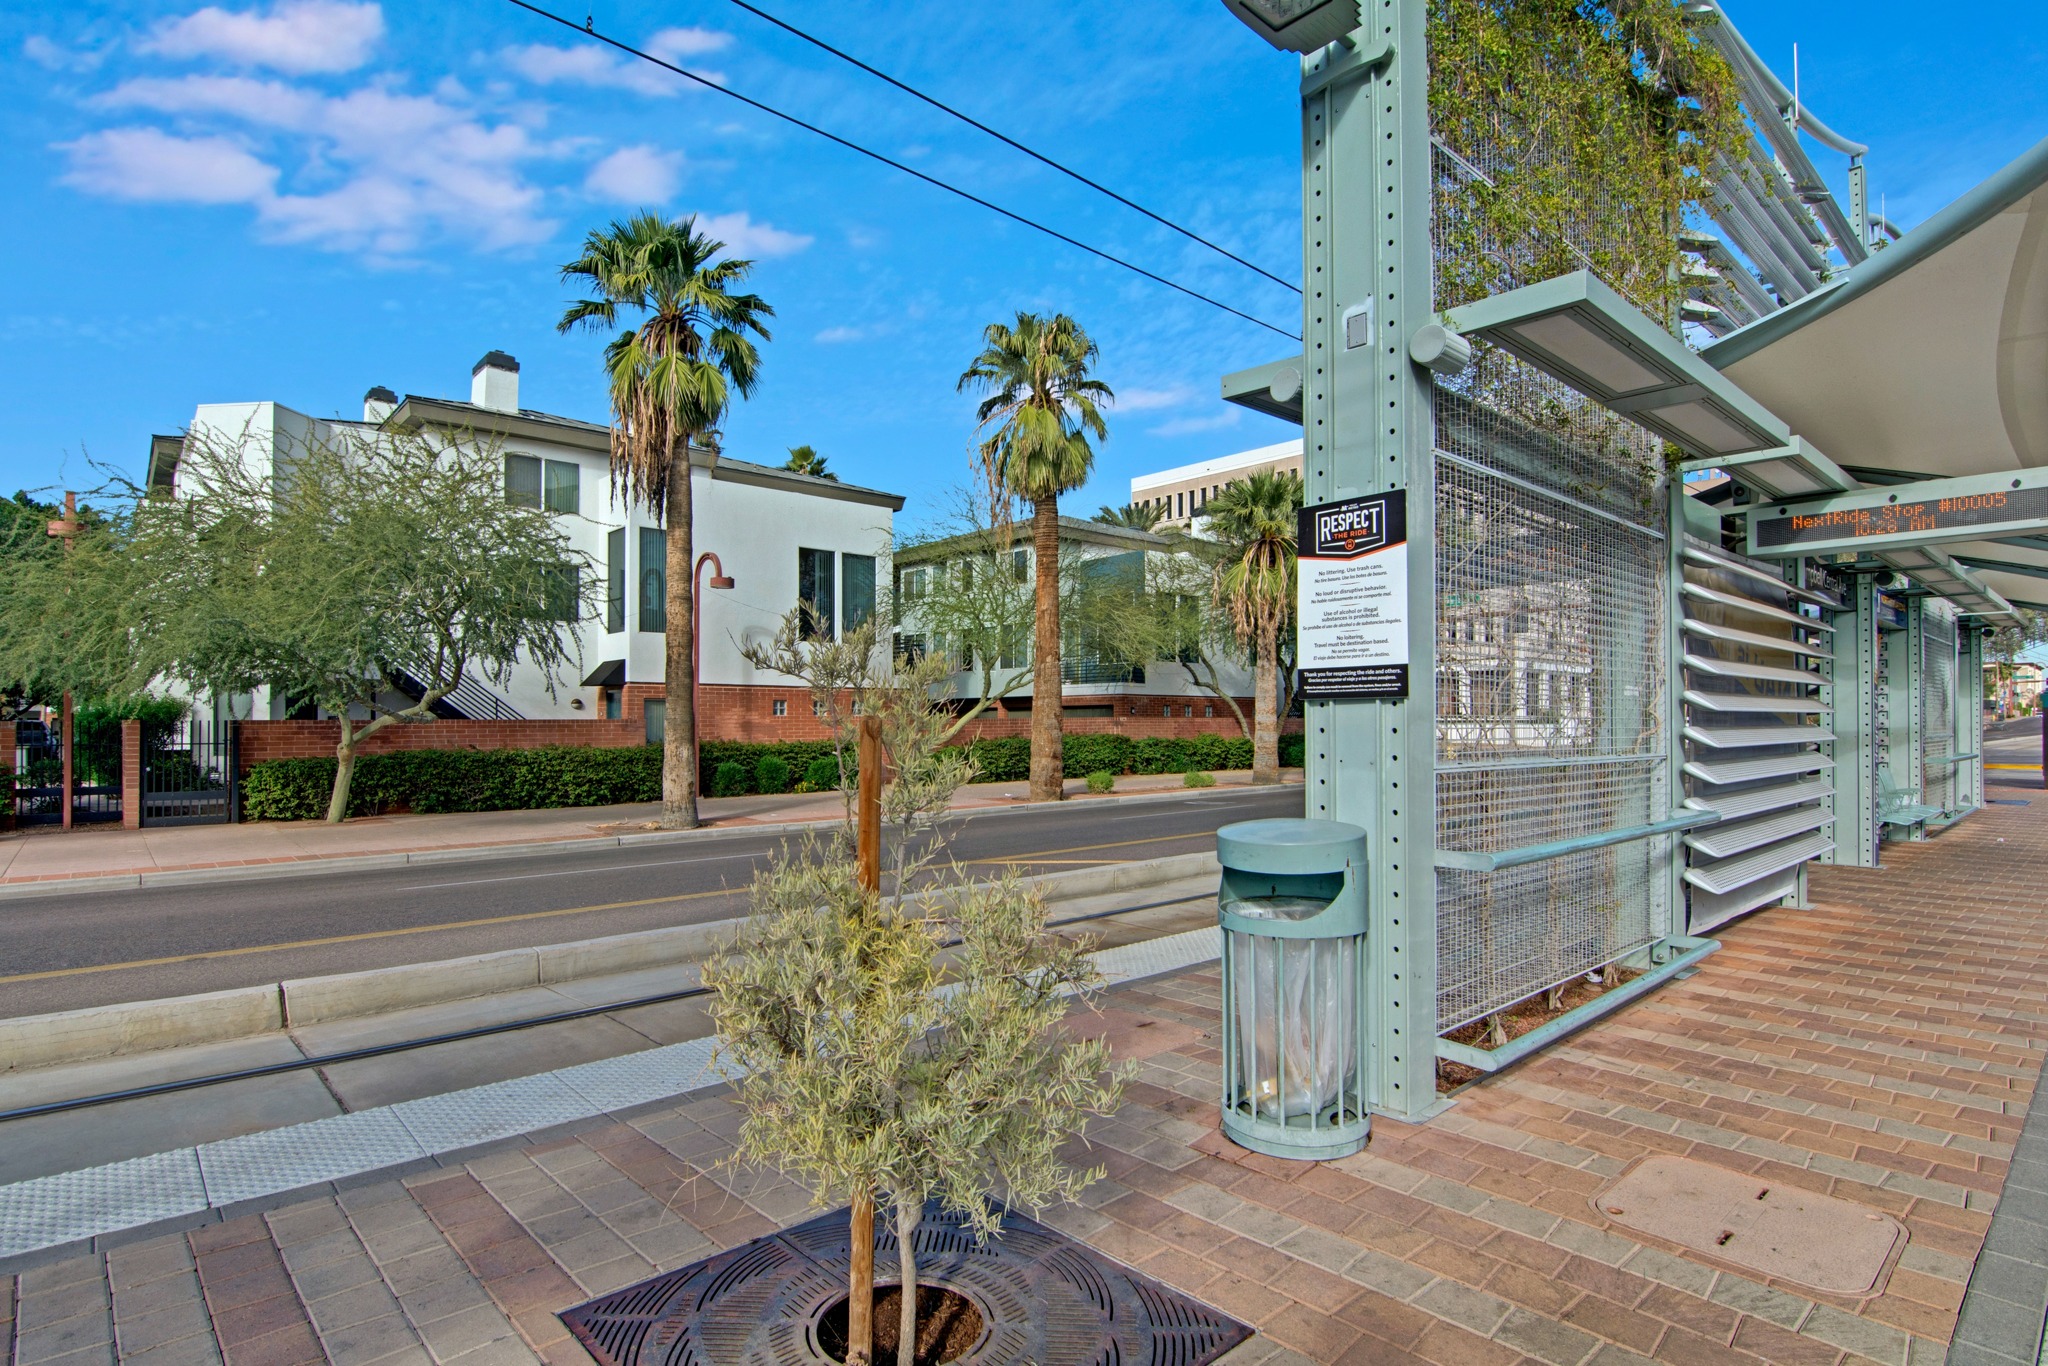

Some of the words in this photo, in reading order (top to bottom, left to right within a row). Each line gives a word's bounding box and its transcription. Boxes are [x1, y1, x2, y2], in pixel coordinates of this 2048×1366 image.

[1793, 508, 1870, 529] NextRide
[1882, 504, 1926, 519] Stop
[1938, 492, 2007, 512] #10005
[1910, 514, 1935, 531] AM
[1320, 508, 1380, 542] RESPECT
[1350, 528, 1367, 536] RIDE
